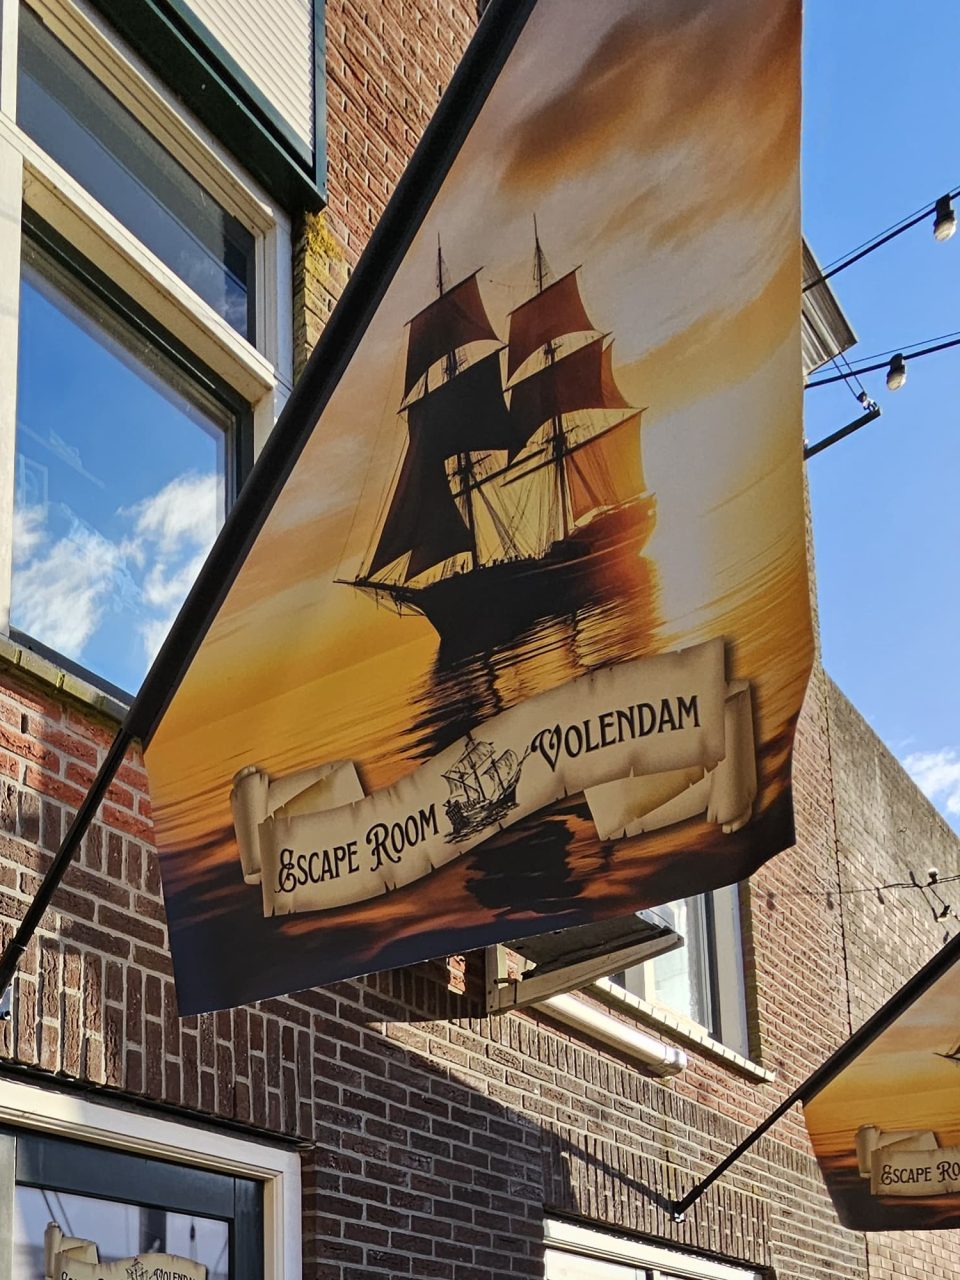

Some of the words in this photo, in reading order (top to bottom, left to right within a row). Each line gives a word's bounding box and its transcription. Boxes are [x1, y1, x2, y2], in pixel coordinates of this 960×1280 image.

[275, 840, 360, 893] ESCAPE
[366, 803, 439, 872] ROOM
[531, 695, 700, 772] VOLENDAM
[880, 1164, 932, 1185] ESCAPE
